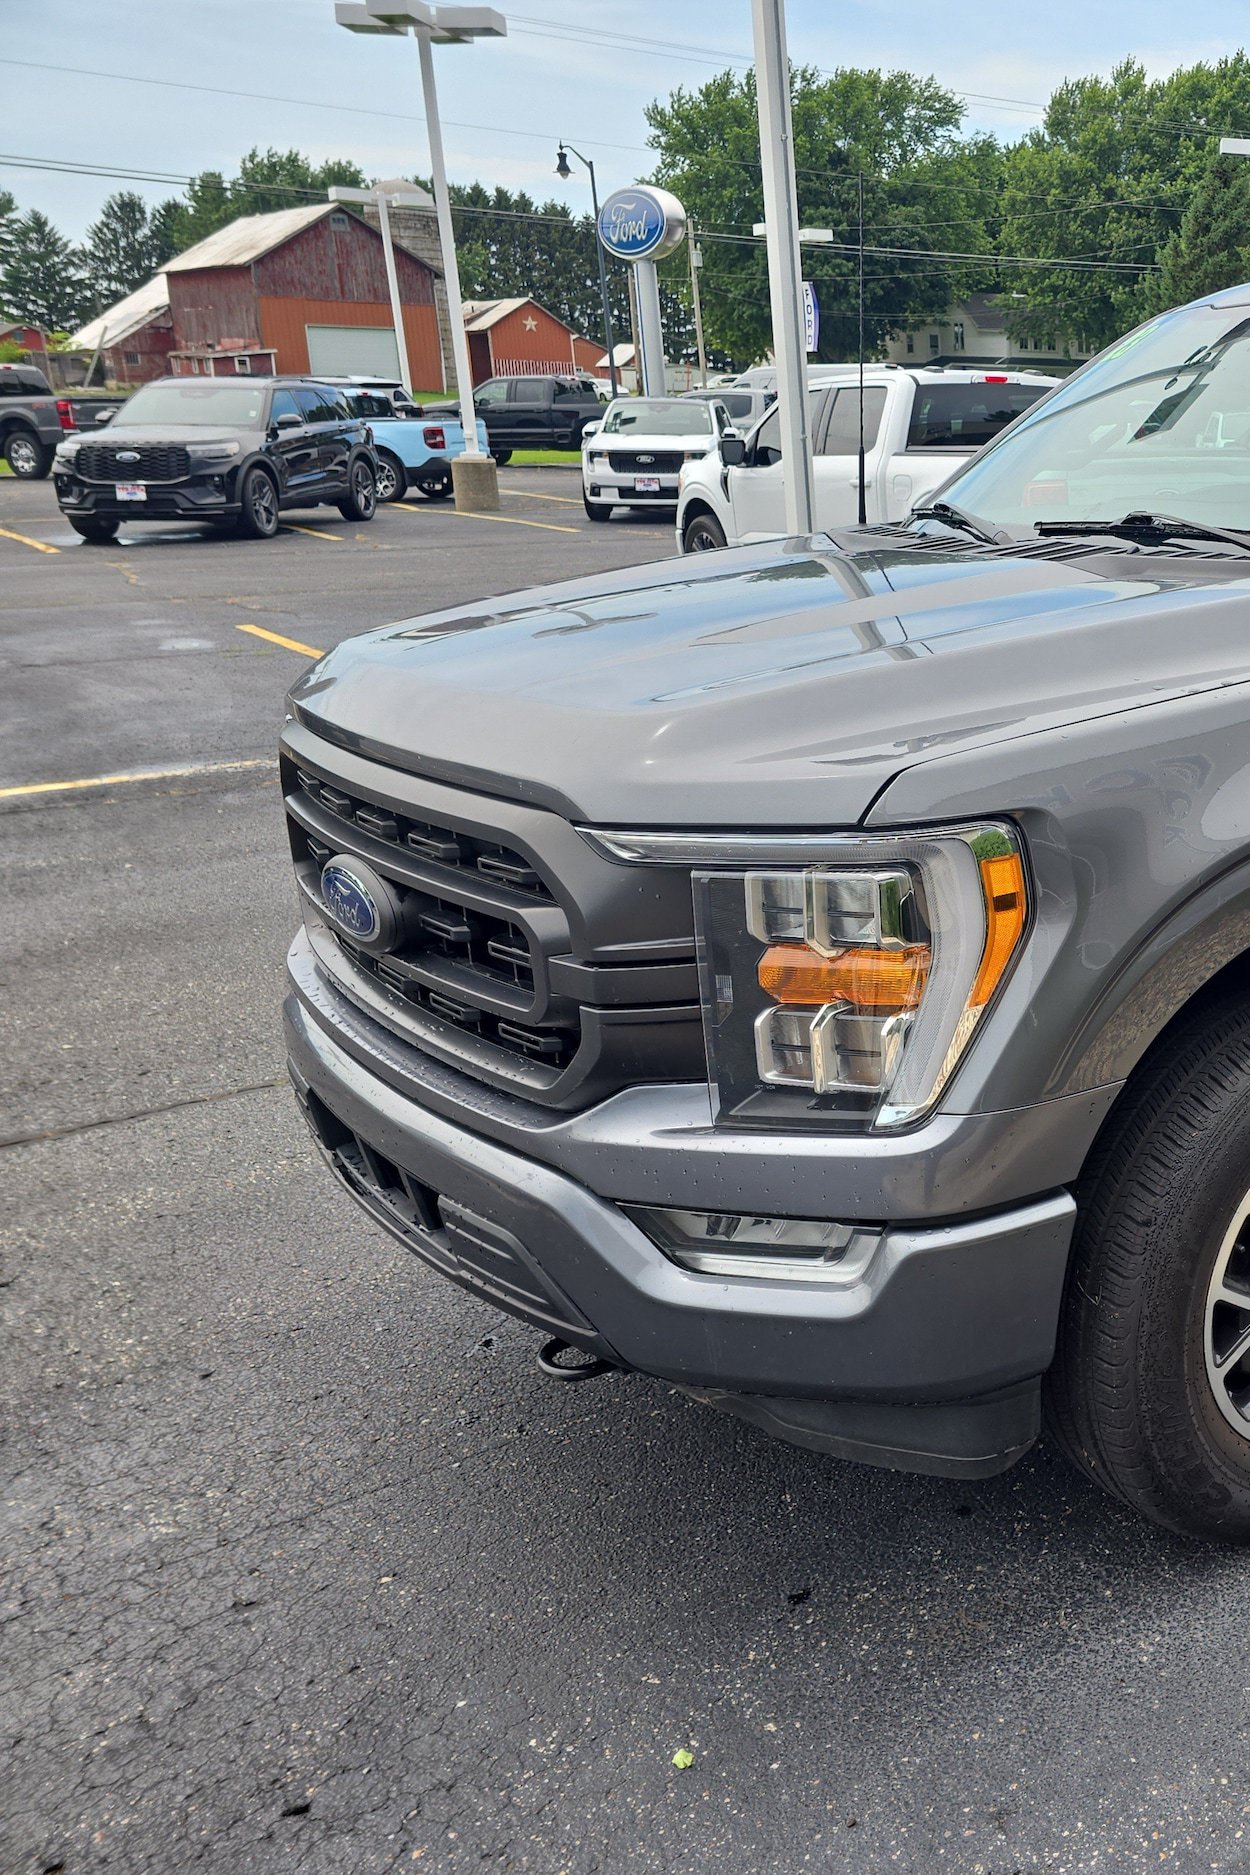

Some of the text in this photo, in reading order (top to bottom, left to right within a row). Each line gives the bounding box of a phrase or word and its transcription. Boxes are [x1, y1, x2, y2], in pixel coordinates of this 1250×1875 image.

[609, 202, 649, 244] Ford
[804, 288, 813, 346] FORD
[327, 879, 362, 928] Ford
